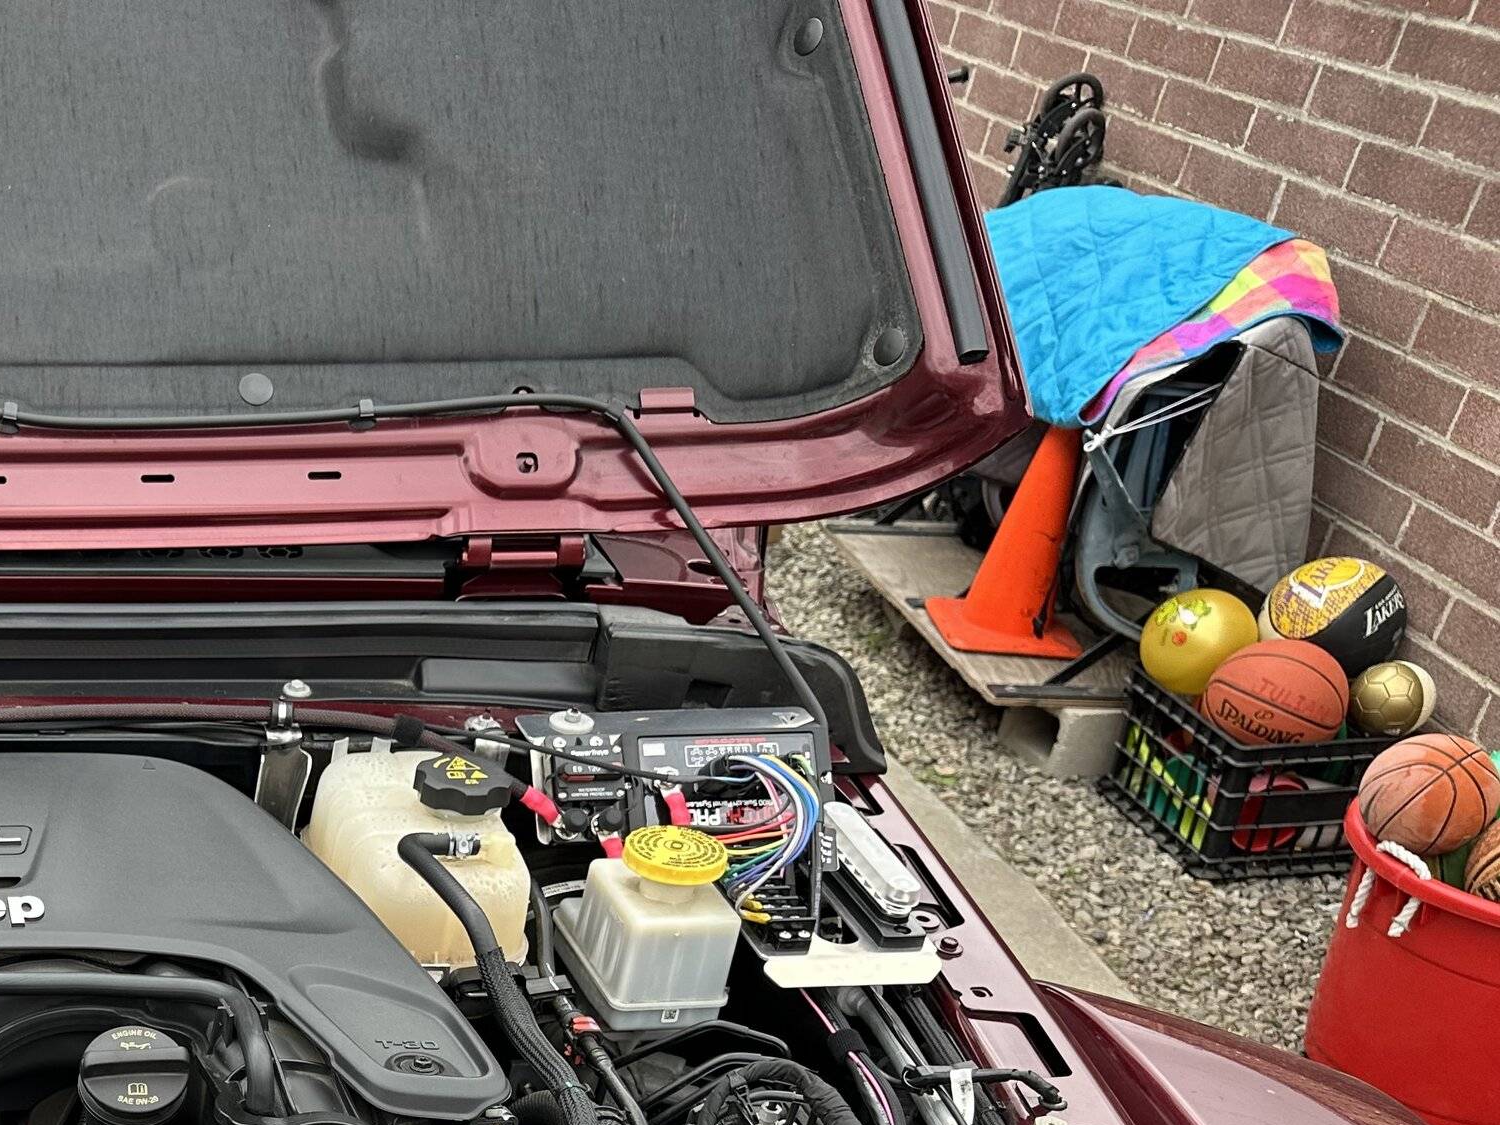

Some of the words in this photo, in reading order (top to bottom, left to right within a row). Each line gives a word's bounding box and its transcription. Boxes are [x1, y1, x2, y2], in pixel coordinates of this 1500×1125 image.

[1215, 698, 1305, 744] SPALDING
[111, 1029, 143, 1040] ENGINE
[143, 1029, 157, 1040] OIL
[374, 1040, 440, 1051] T-30
[117, 1095, 134, 1105] SAE
